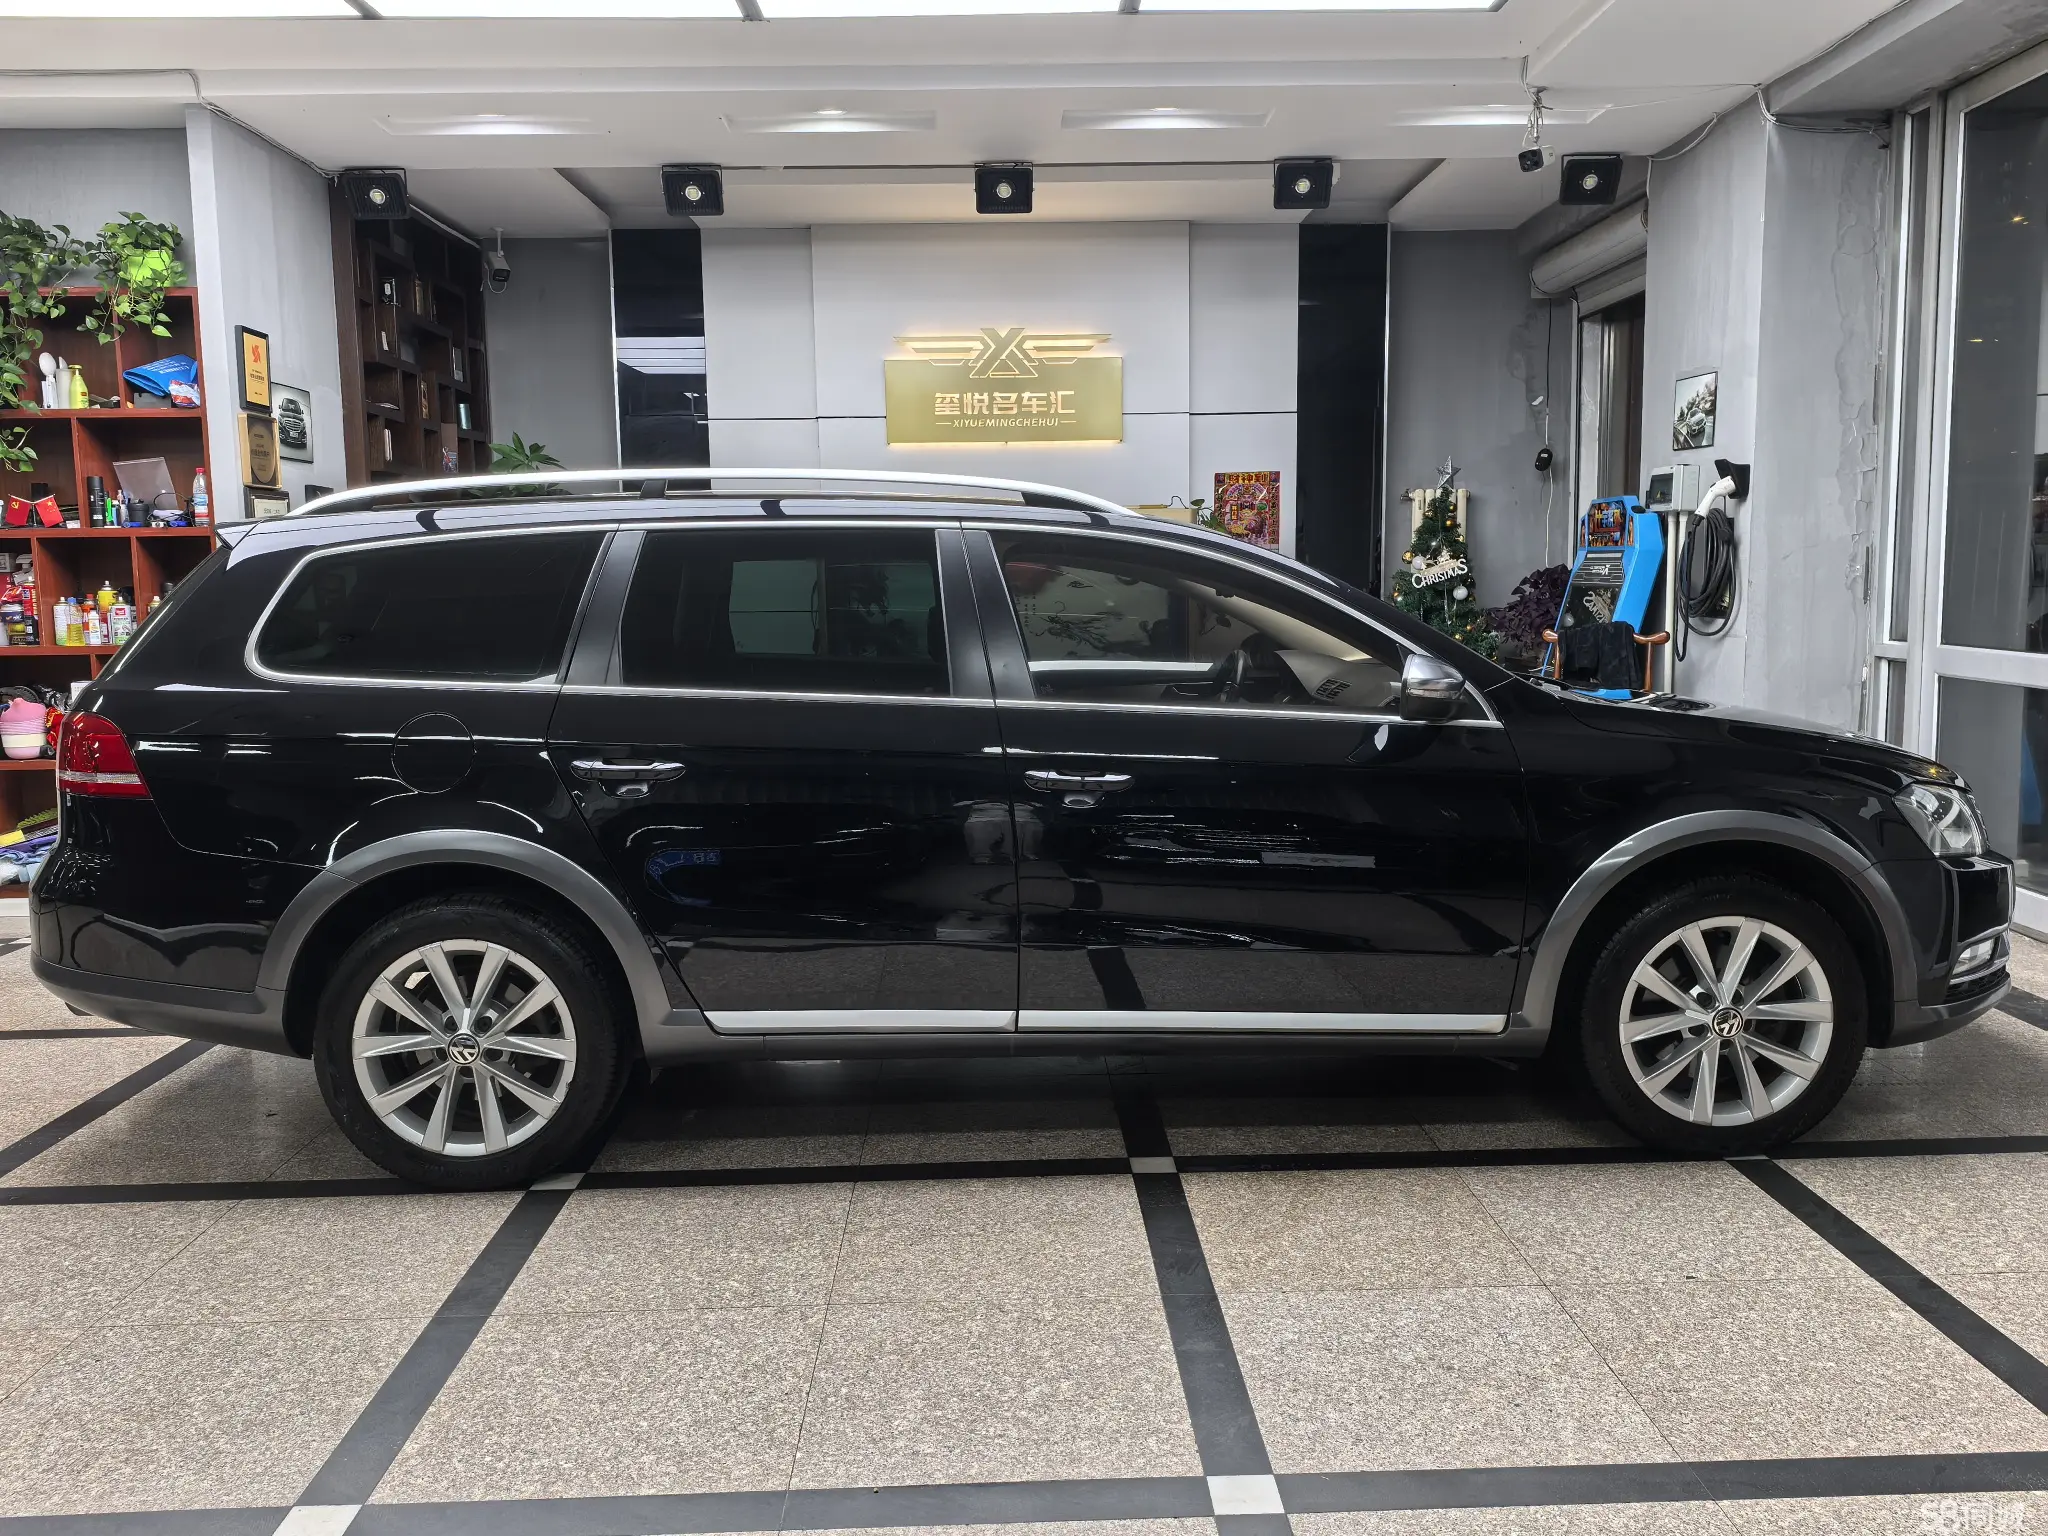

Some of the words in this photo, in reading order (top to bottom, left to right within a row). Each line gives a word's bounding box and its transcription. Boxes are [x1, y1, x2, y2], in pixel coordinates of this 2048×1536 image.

[935, 391, 1076, 415] 玺悦名车汇
[953, 418, 1059, 428] XIYUEMINGCHEHUI
[1412, 558, 1468, 589] CHRISTMAS
